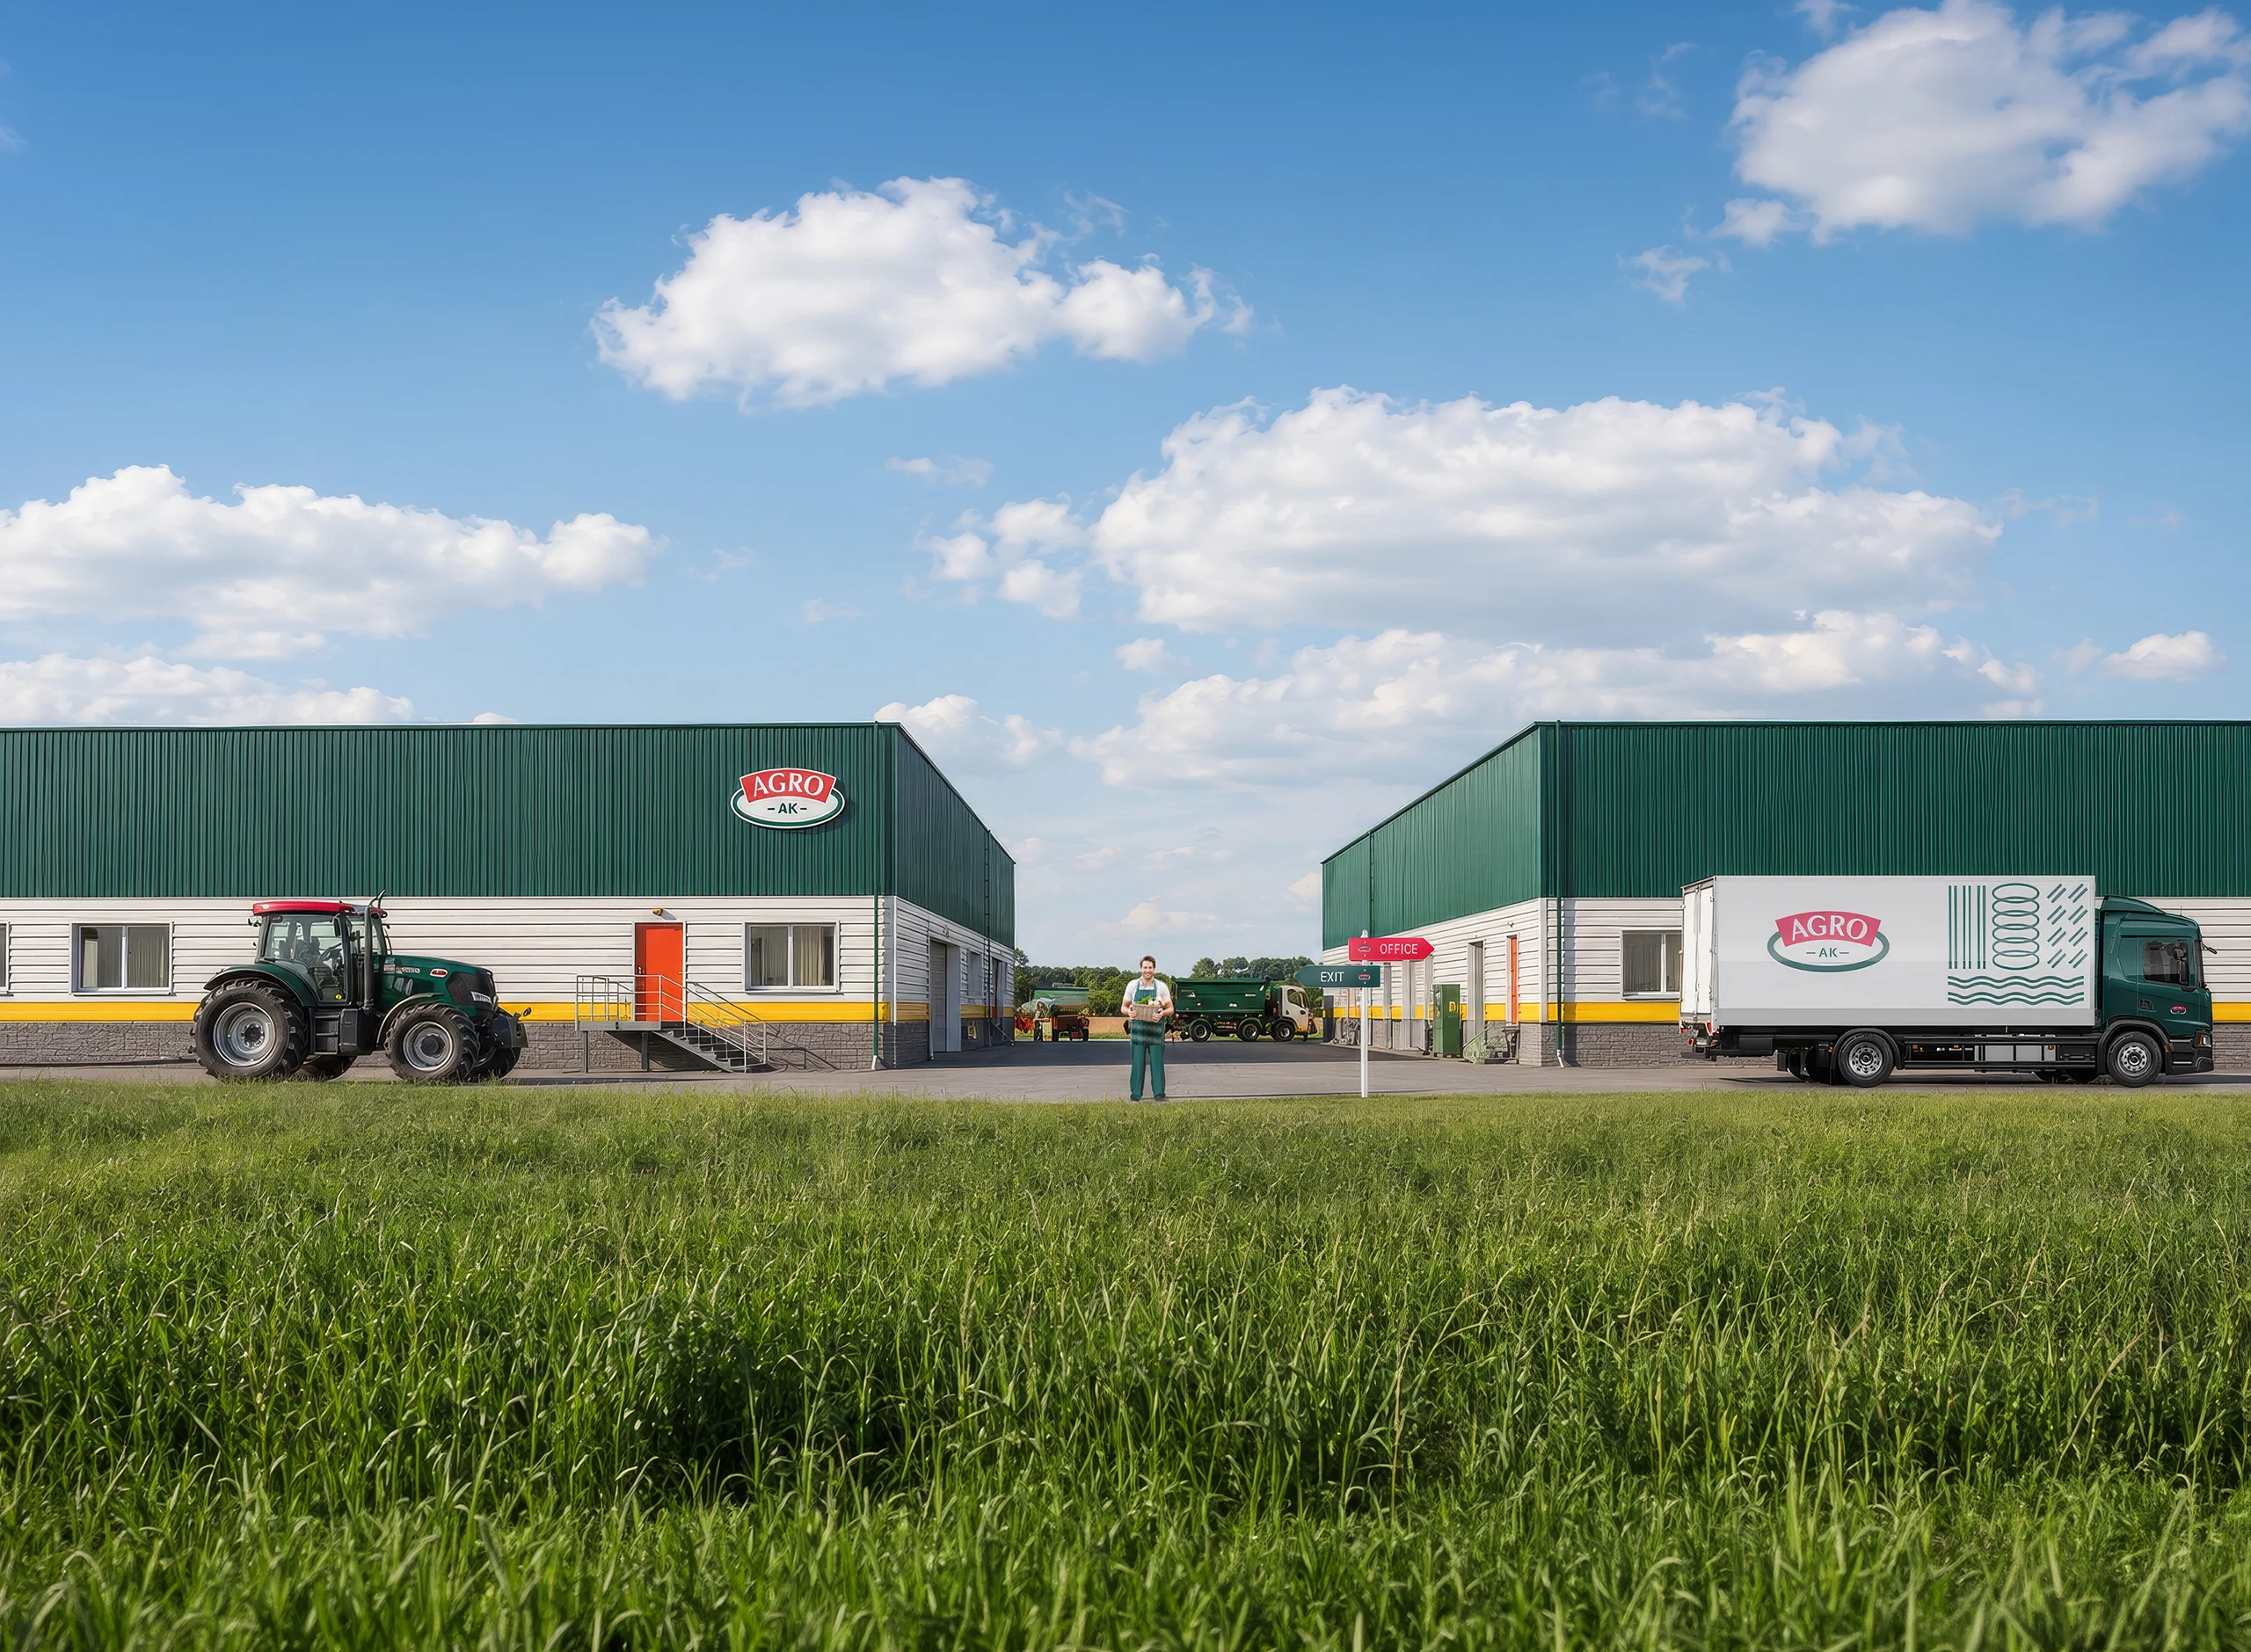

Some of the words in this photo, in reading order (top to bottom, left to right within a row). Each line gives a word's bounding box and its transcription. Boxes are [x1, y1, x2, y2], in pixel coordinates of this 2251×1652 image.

[754, 772, 824, 797] AGRO
[1792, 914, 1869, 942] AGRO
[1380, 943, 1418, 955] OFFICE
[1320, 972, 1344, 982] EXIT
